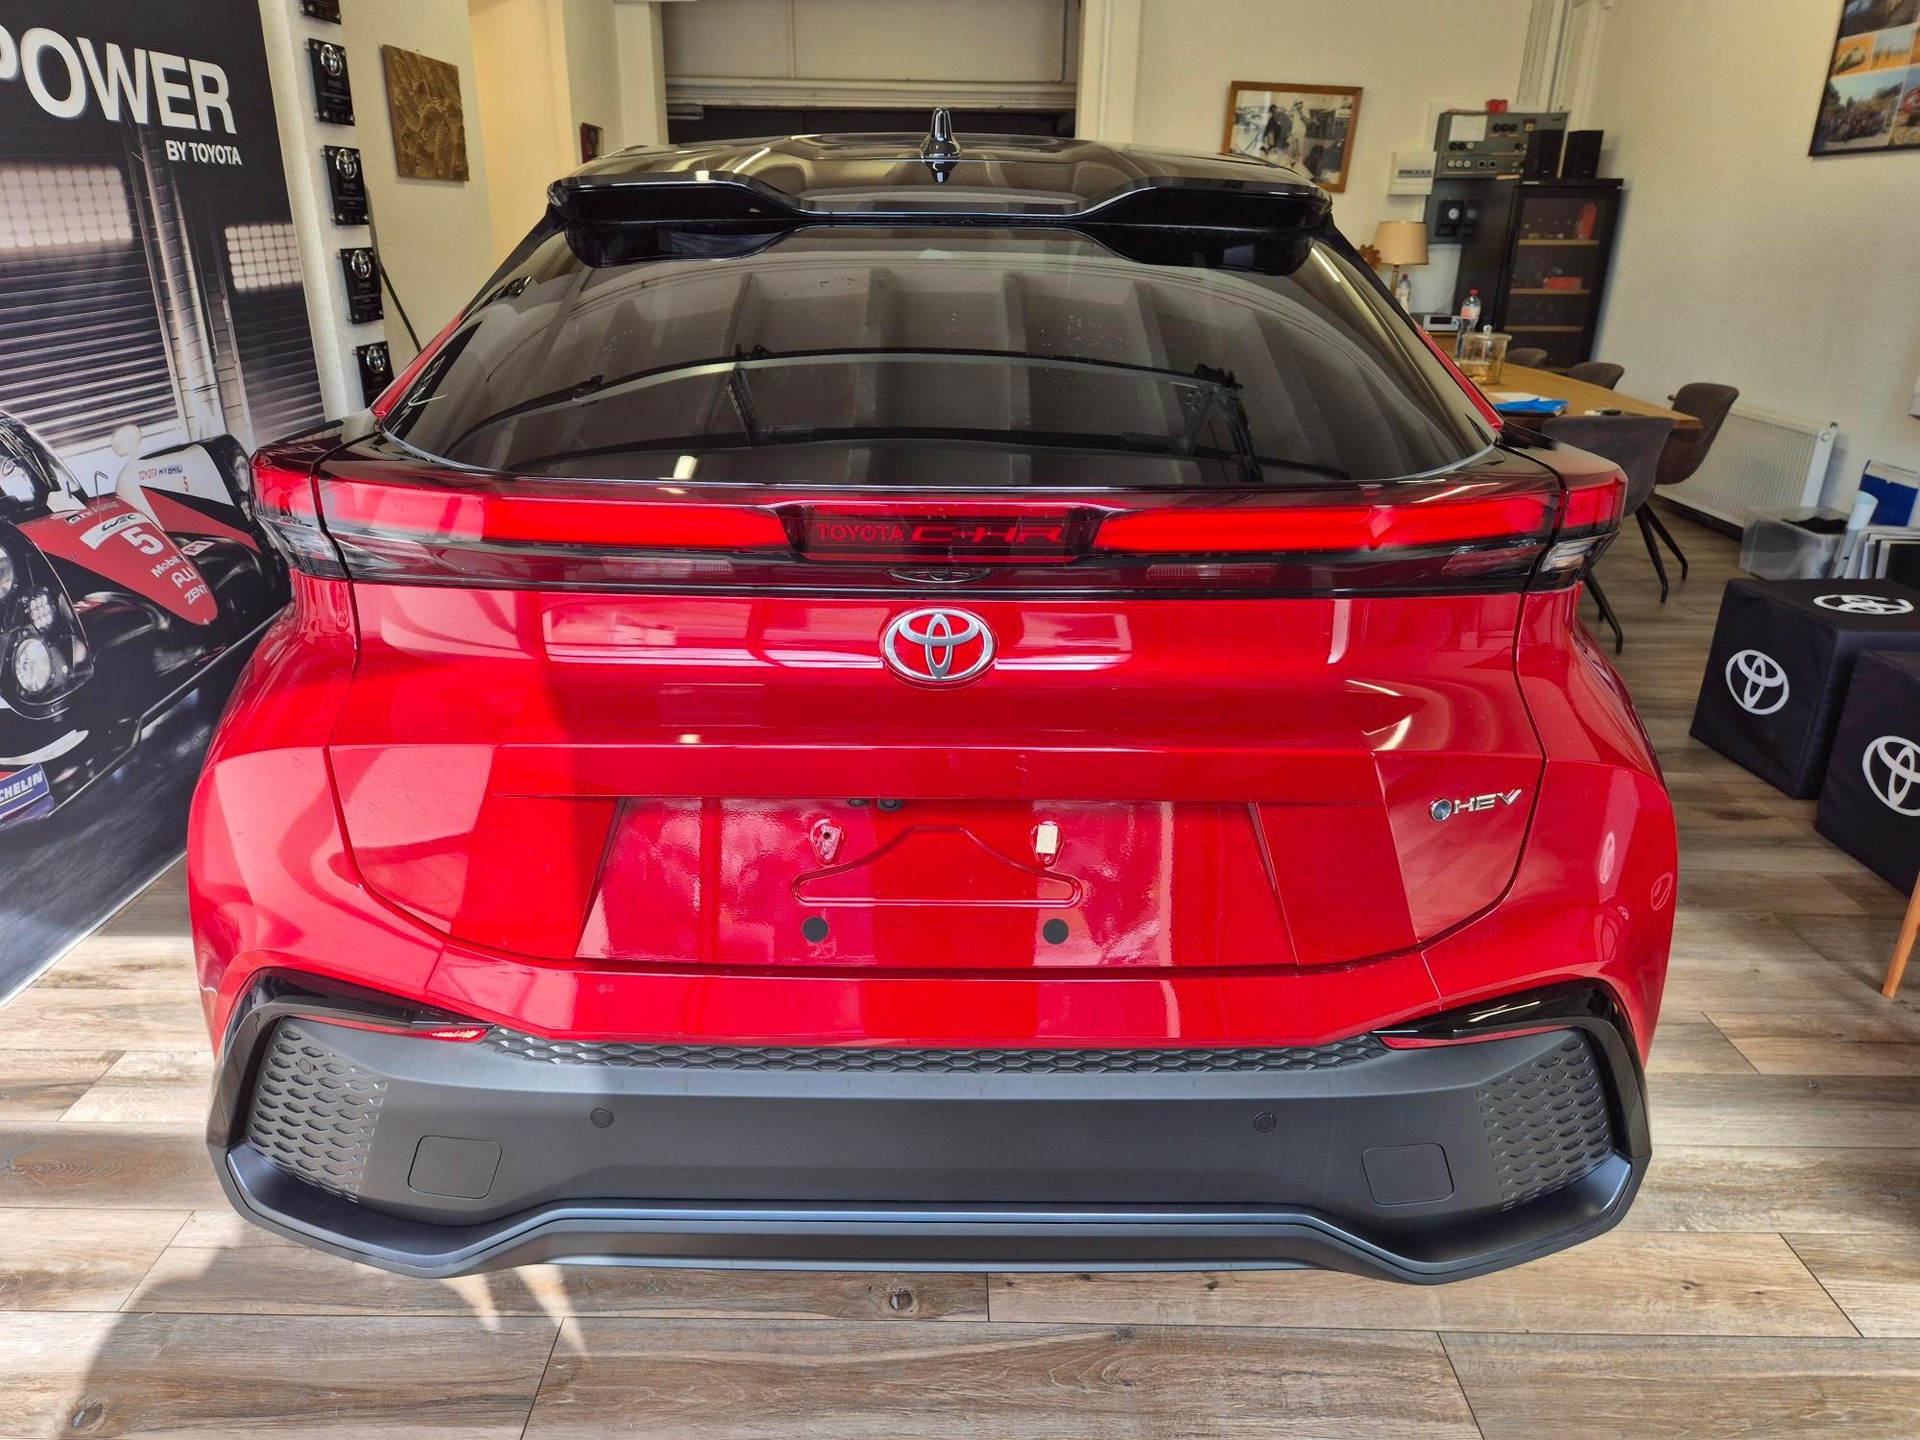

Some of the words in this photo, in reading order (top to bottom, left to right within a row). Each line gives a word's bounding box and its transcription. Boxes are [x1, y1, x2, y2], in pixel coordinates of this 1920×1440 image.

[165, 140, 186, 161] BY
[189, 143, 243, 165] TOYOTA
[120, 526, 163, 555] 5
[815, 524, 904, 542] TOYOTA
[1453, 788, 1522, 815] HEV
